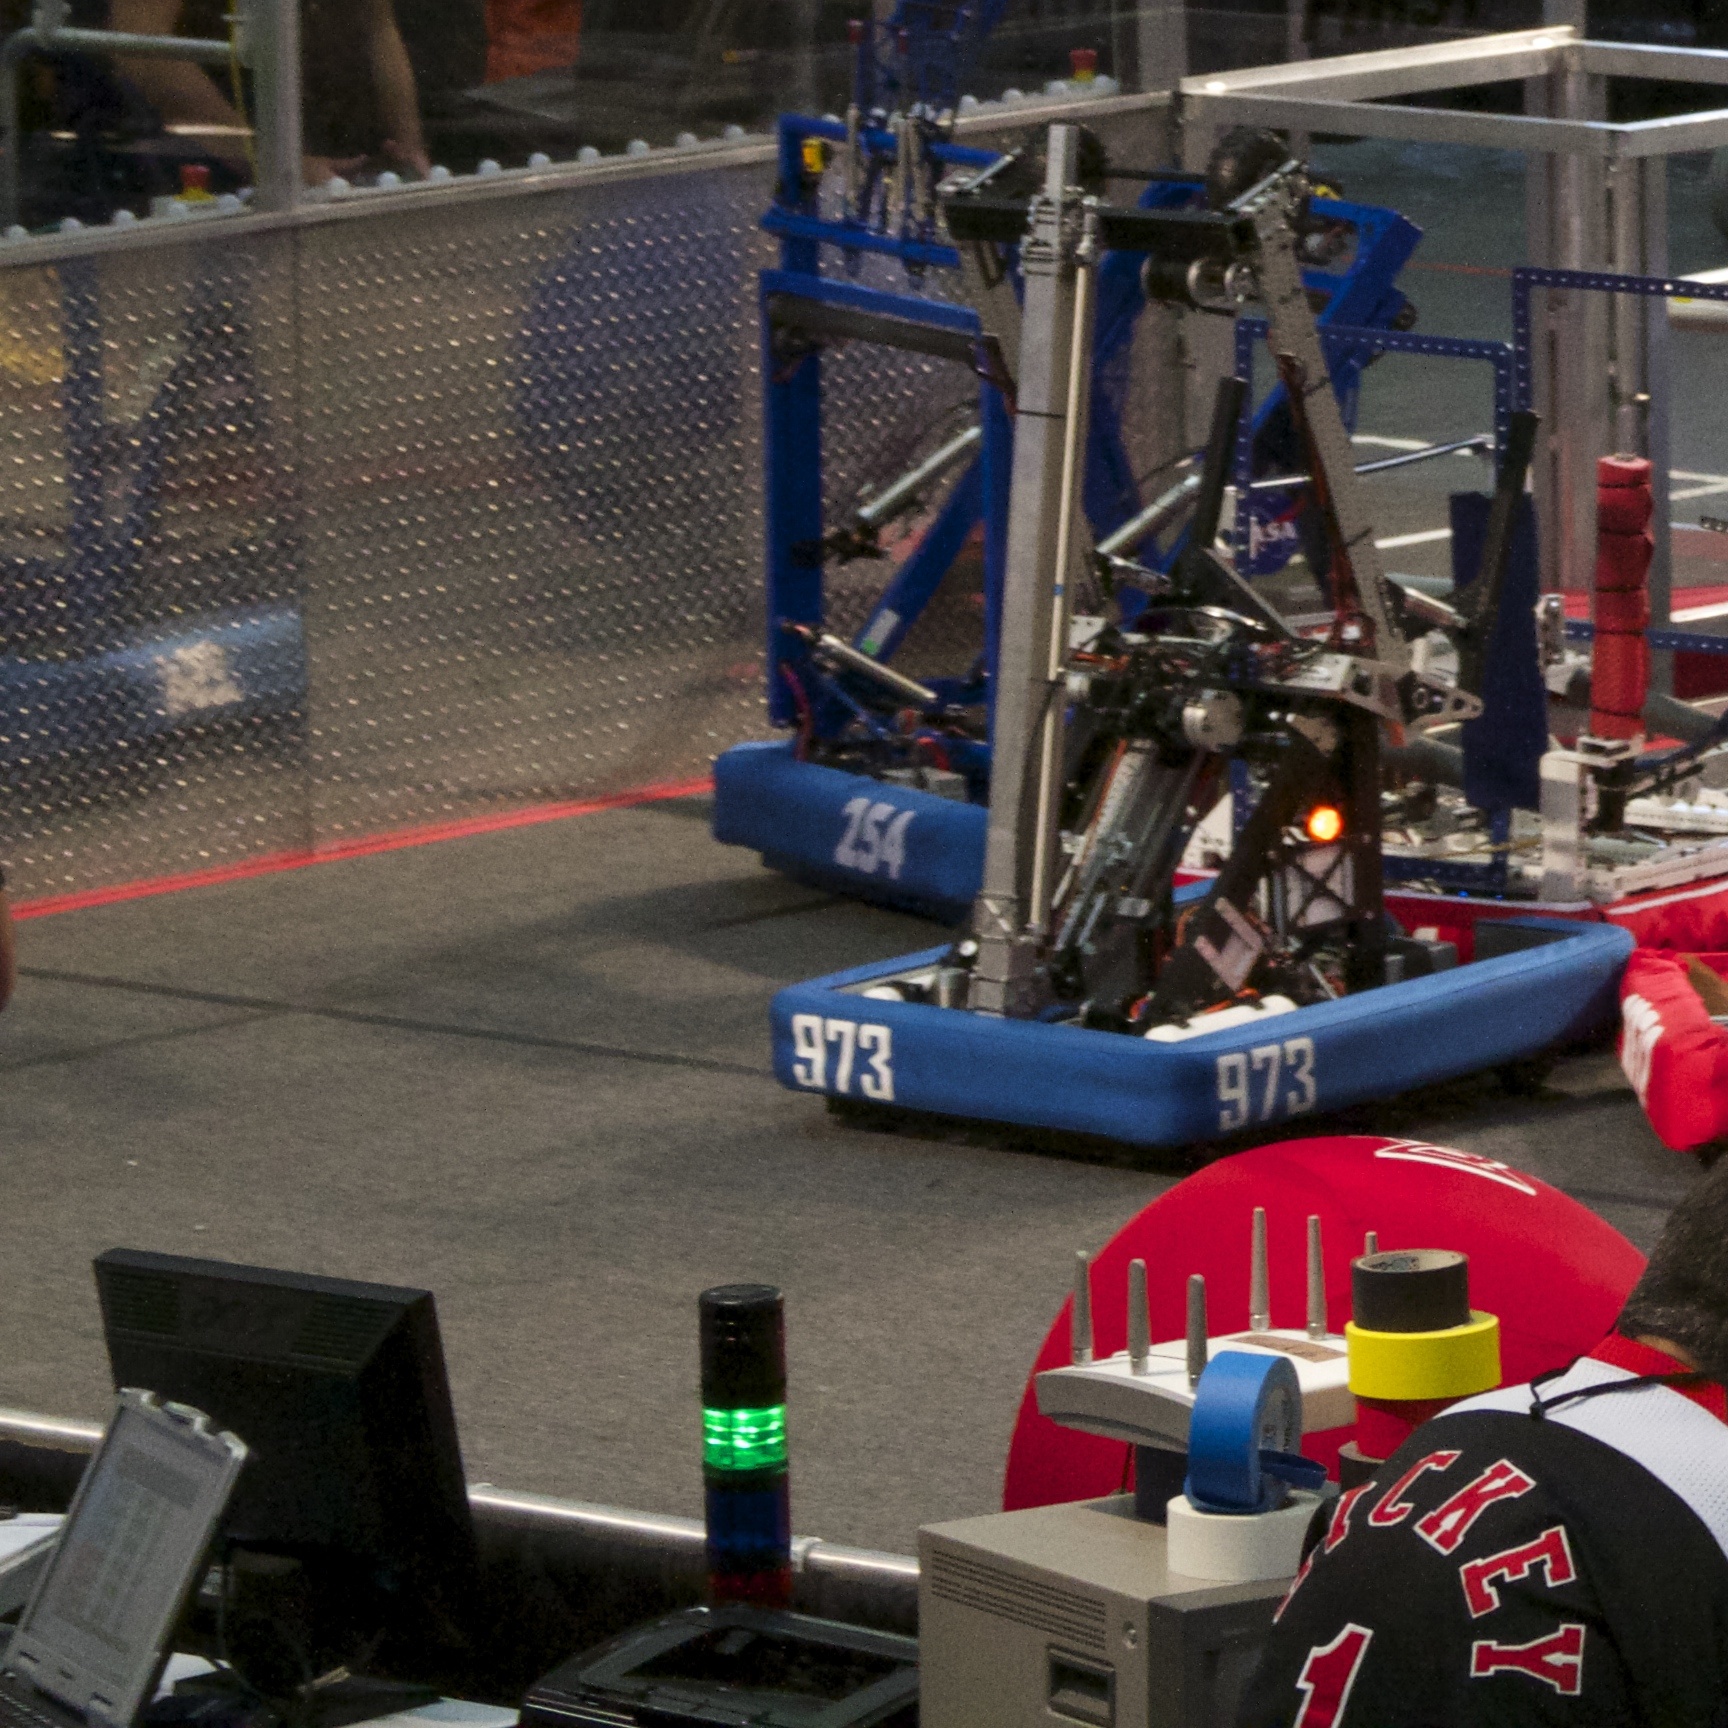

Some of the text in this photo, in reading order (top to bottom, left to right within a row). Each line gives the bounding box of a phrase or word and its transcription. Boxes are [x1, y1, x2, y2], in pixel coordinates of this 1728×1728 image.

[833, 797, 917, 880] 254
[792, 1014, 895, 1102] 973
[1216, 1037, 1316, 1132] 973
[1272, 1449, 1586, 1696] ICKEY
